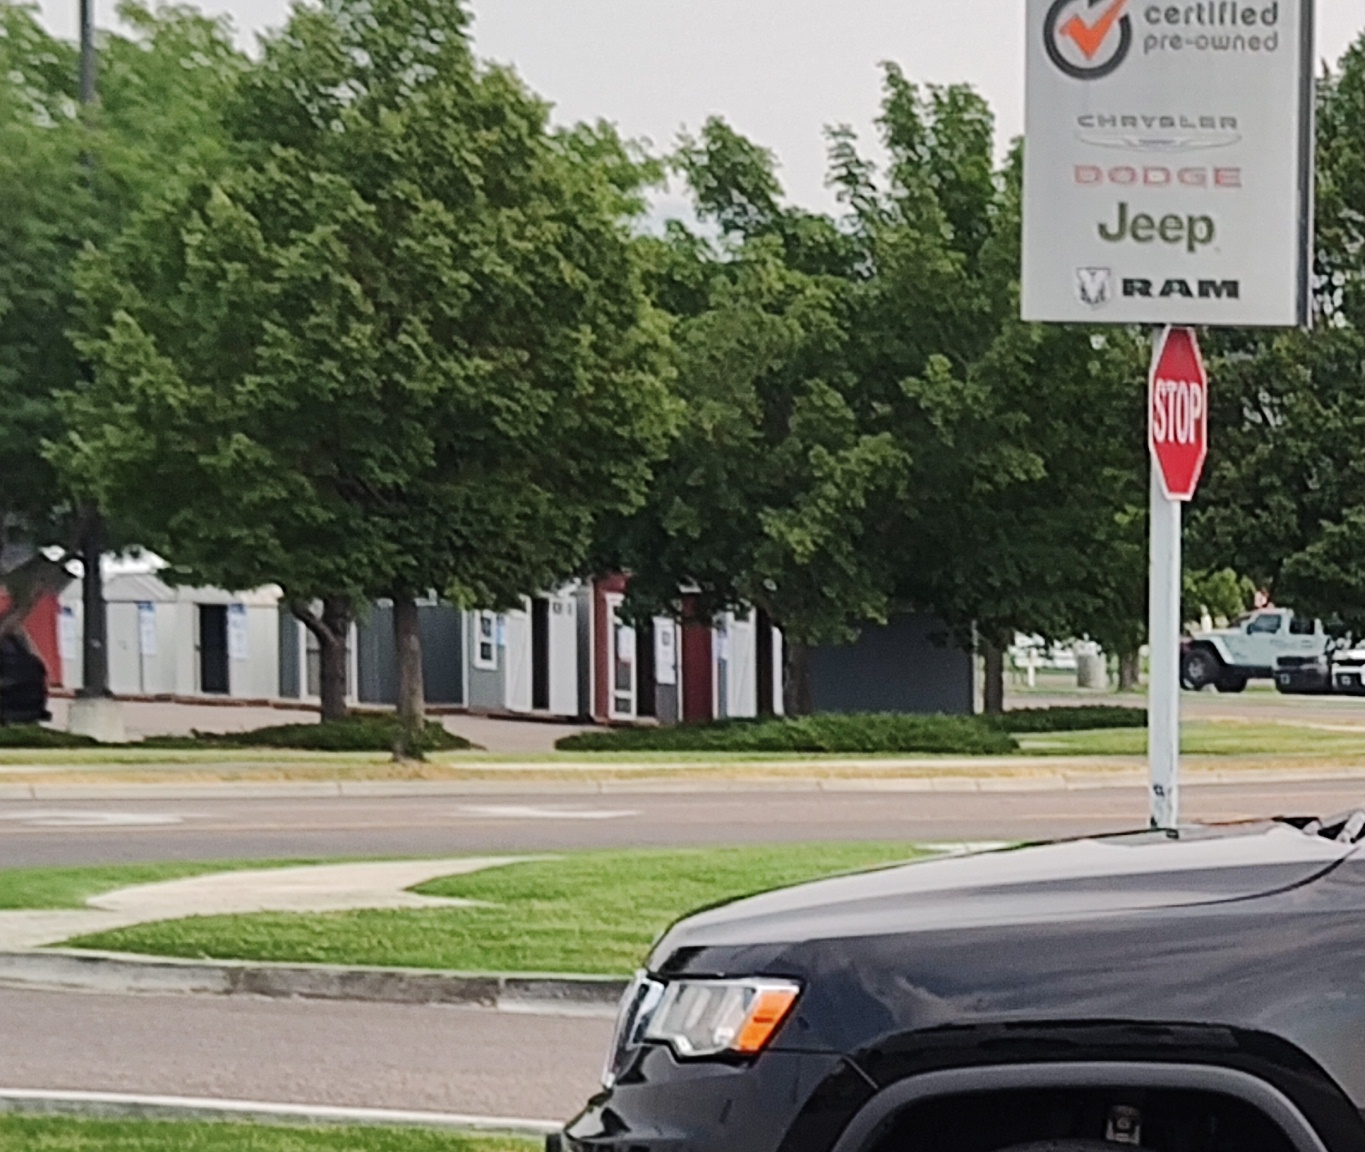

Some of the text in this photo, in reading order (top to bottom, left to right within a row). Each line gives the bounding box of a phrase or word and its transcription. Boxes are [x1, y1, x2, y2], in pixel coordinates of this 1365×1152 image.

[1144, 0, 1278, 26] certified
[1143, 31, 1278, 54] pre-owned
[1076, 115, 1238, 129] CHRYSLER
[1074, 165, 1242, 188] DODGE
[1098, 202, 1215, 252] Jeep
[1122, 278, 1240, 299] RAM
[1153, 378, 1202, 443] STOP
